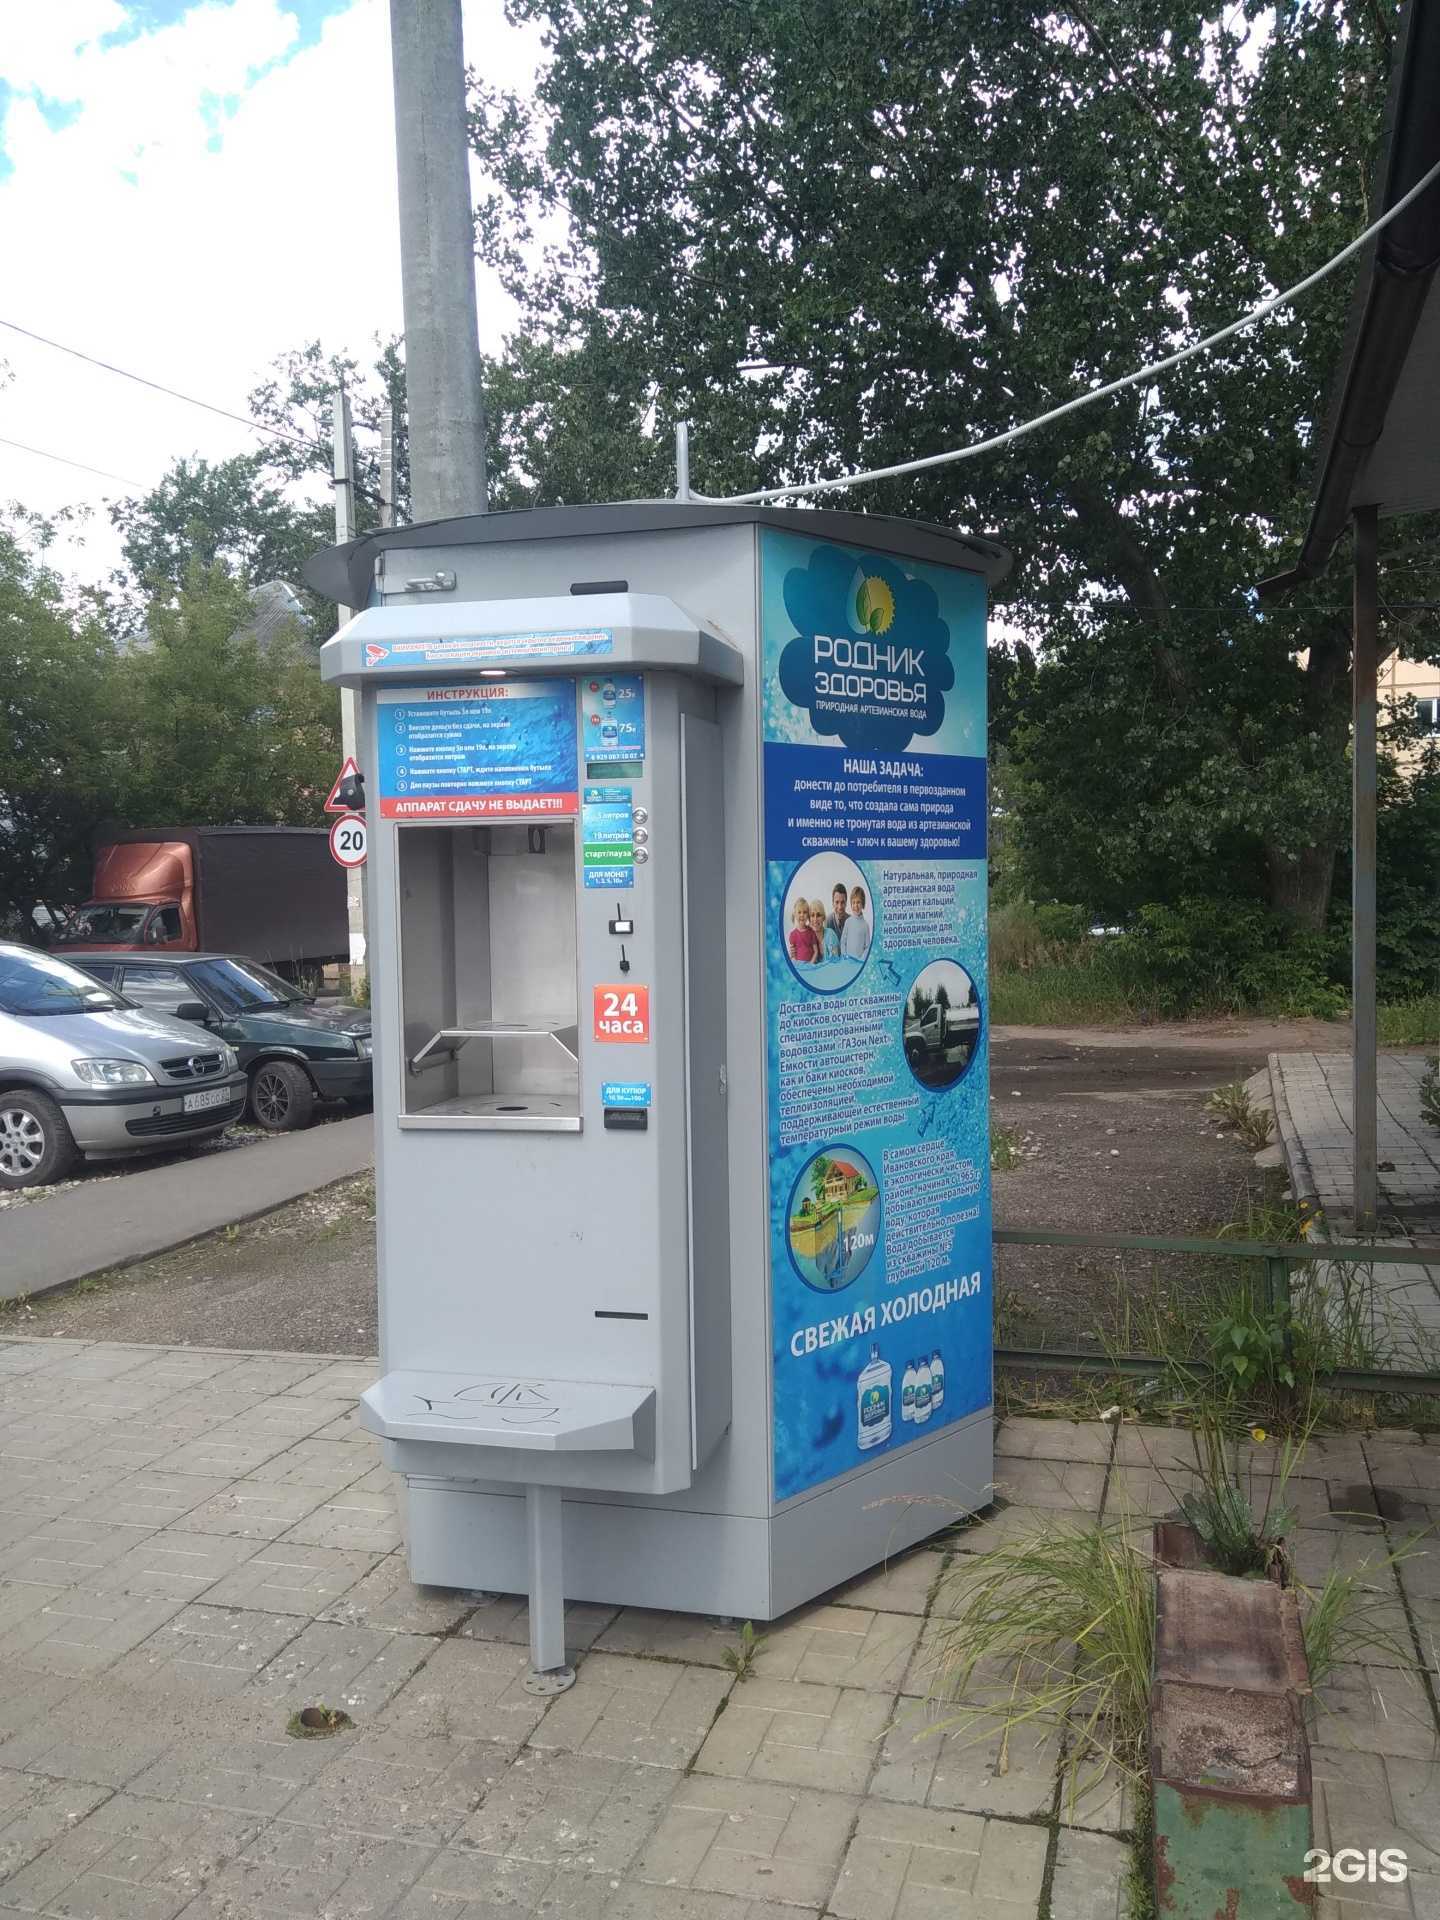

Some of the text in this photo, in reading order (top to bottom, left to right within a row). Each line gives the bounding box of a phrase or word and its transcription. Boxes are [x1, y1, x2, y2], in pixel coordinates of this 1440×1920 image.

[814, 634, 925, 677] РОДНИК
[427, 687, 509, 700] ИНСТРУКЦИЯ:
[814, 671, 927, 704] ЗДОРОВЬЯ
[815, 700, 927, 720] ПРИРОДНАЯ АРТЕЗИАНСКАЯ ВОДА
[843, 758, 924, 778] НАША ЗАДАЧА:
[794, 779, 966, 797] донести до потребителя в первозданном
[395, 801, 449, 813] АППАРАТ
[448, 800, 487, 813] СДАЧУ
[488, 799, 503, 810] НЕ
[810, 799, 954, 815] виде то, что создала сама природа
[788, 818, 972, 832] и именно не тронутая вода из артезианской
[340, 830, 364, 851] 20
[802, 836, 961, 850] скважины ключ к вашему здоровью!
[883, 870, 978, 882] Натуральная, природная
[883, 883, 956, 896] артезианская вода
[883, 898, 921, 909] содержит
[909, 912, 914, 920] и
[883, 922, 953, 935] необходимые для
[883, 937, 922, 950] здоровья
[603, 992, 639, 1017] 24
[779, 993, 901, 1016] Доставка воды от скважины
[598, 1019, 645, 1035] часа
[780, 1006, 899, 1031] до киосков осуществляется
[780, 1022, 884, 1044] специализированными
[780, 1042, 836, 1059] водовозами
[780, 1059, 818, 1073] Емкости
[780, 1065, 866, 1088] как и баки киосков,
[780, 1083, 835, 1102] обеспечены
[780, 1123, 852, 1145] температурный
[853, 1118, 881, 1134] режим
[883, 1139, 945, 1161] В самом сердце
[883, 1150, 955, 1174] Ивановского края
[890, 1166, 945, 1188] экологически
[945, 1159, 973, 1173] чистом
[916, 1177, 950, 1193] начиная
[951, 1176, 956, 1184] с
[957, 1169, 974, 1182] 1965
[884, 1182, 980, 1217] добывают минеральную
[908, 1206, 940, 1221] которая
[885, 1217, 946, 1243] действительно
[886, 1228, 955, 1256] Вода добывается
[886, 1259, 897, 1269] из
[790, 1271, 981, 1357] СВЕЖАЯ ХОЛОДНАЯ
